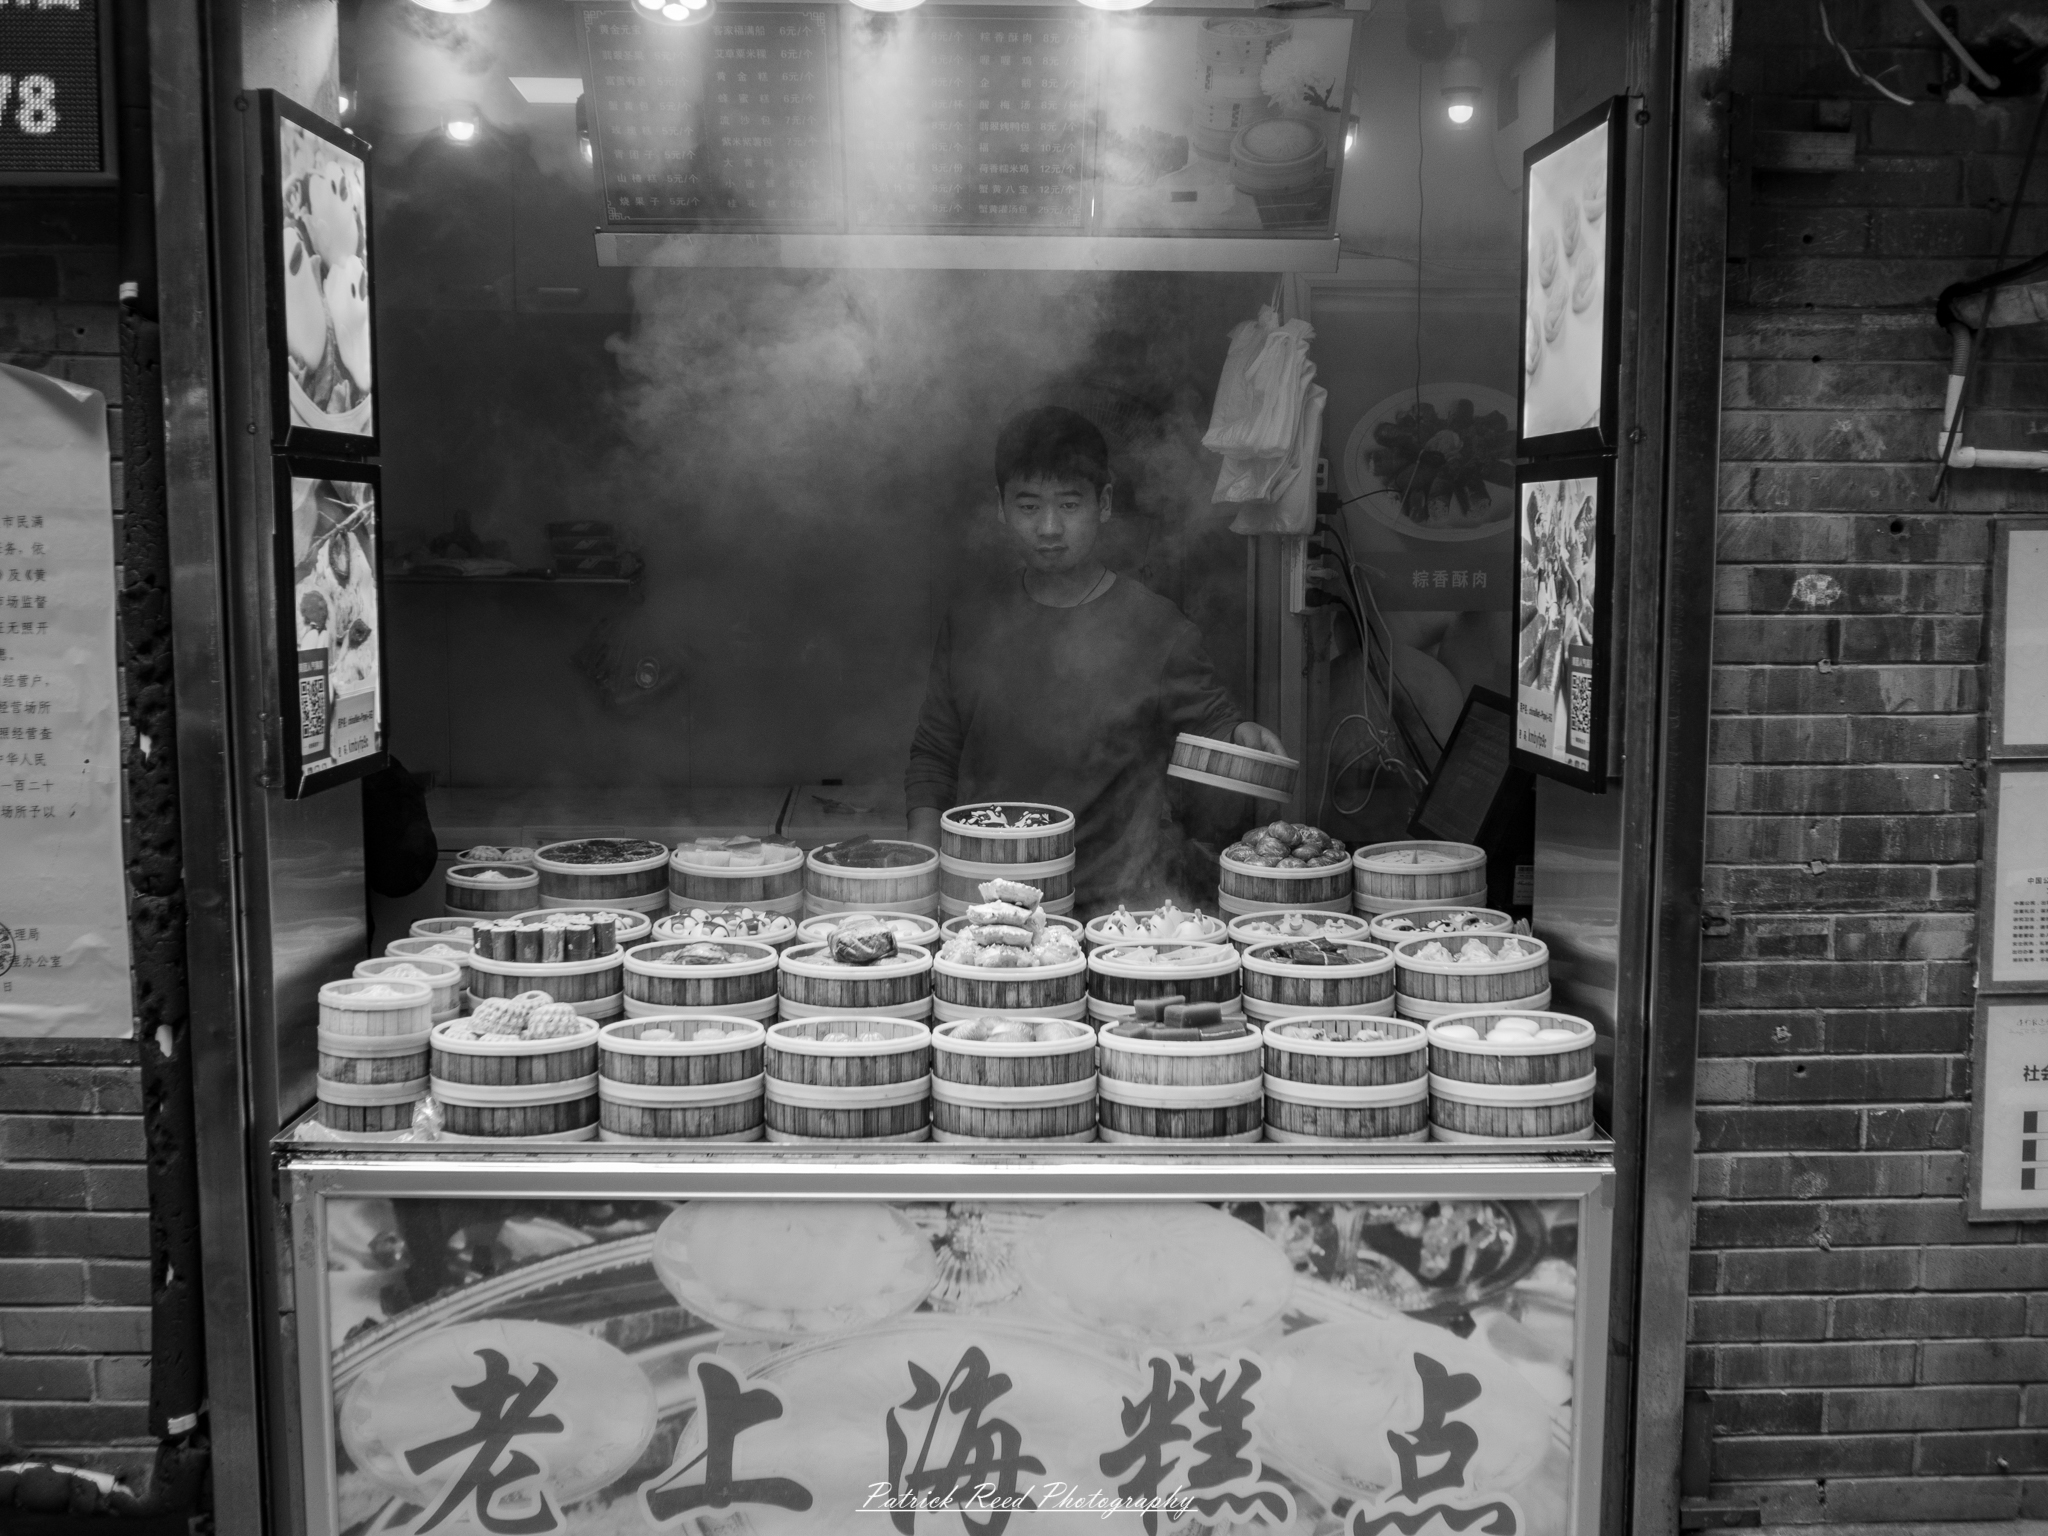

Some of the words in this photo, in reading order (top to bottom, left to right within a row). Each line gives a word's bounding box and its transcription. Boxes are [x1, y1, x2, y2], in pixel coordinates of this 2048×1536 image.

[600, 25, 641, 35] 黄金元宝
[713, 25, 766, 36] 客家福满船
[779, 26, 812, 37] 6元/个
[930, 31, 964, 42] 8元/个
[980, 32, 1032, 44] 粽香酥肉
[780, 49, 813, 60] 6元/个
[716, 72, 768, 82] 黄金糕
[782, 72, 814, 82] 6元/个
[930, 77, 964, 88] 8元/个
[980, 78, 1032, 88] 企鹅
[718, 94, 770, 104] 蜂蜜糕
[783, 94, 815, 104] 6元/个
[931, 99, 964, 110] 8元/杯
[660, 102, 691, 112] 5元/个
[979, 100, 1031, 111] 酸梅汤
[720, 116, 772, 126] 流沙包
[785, 116, 816, 126] 7元/个
[931, 121, 964, 132] 8元/个
[662, 126, 694, 137] 5元/个
[979, 122, 1030, 132] 翡翠烤鸭包
[722, 137, 772, 147] 紫米紫薯包
[786, 137, 818, 148] 7元/个
[932, 142, 964, 152] 8元/个
[979, 143, 1030, 153] 福袋
[1040, 144, 1076, 154] 10元/个
[614, 149, 654, 160] 青团子
[664, 150, 696, 160] 5元/个
[723, 158, 774, 168] 大黄鸭
[932, 163, 964, 174] 8元/份
[979, 164, 1029, 174] 荷香糯米鸡
[1040, 164, 1076, 174] 12元/个
[617, 173, 658, 184] 山楂糕
[666, 174, 698, 185] 5元/个
[932, 183, 963, 194] 8元/个
[978, 184, 1028, 194] 蟹黄八宝
[1040, 185, 1075, 194] 12元/个
[620, 197, 660, 207] 烧果子
[670, 197, 700, 207] 5元/个
[932, 203, 962, 213] 8元/个
[978, 204, 1028, 214] 蟹黄灌汤包
[1412, 570, 1488, 588] 粽香酥肉
[1, 779, 54, 792] 一百二十
[1, 805, 55, 819] 场所予以
[403, 1346, 1517, 1536] 老上海糕点
